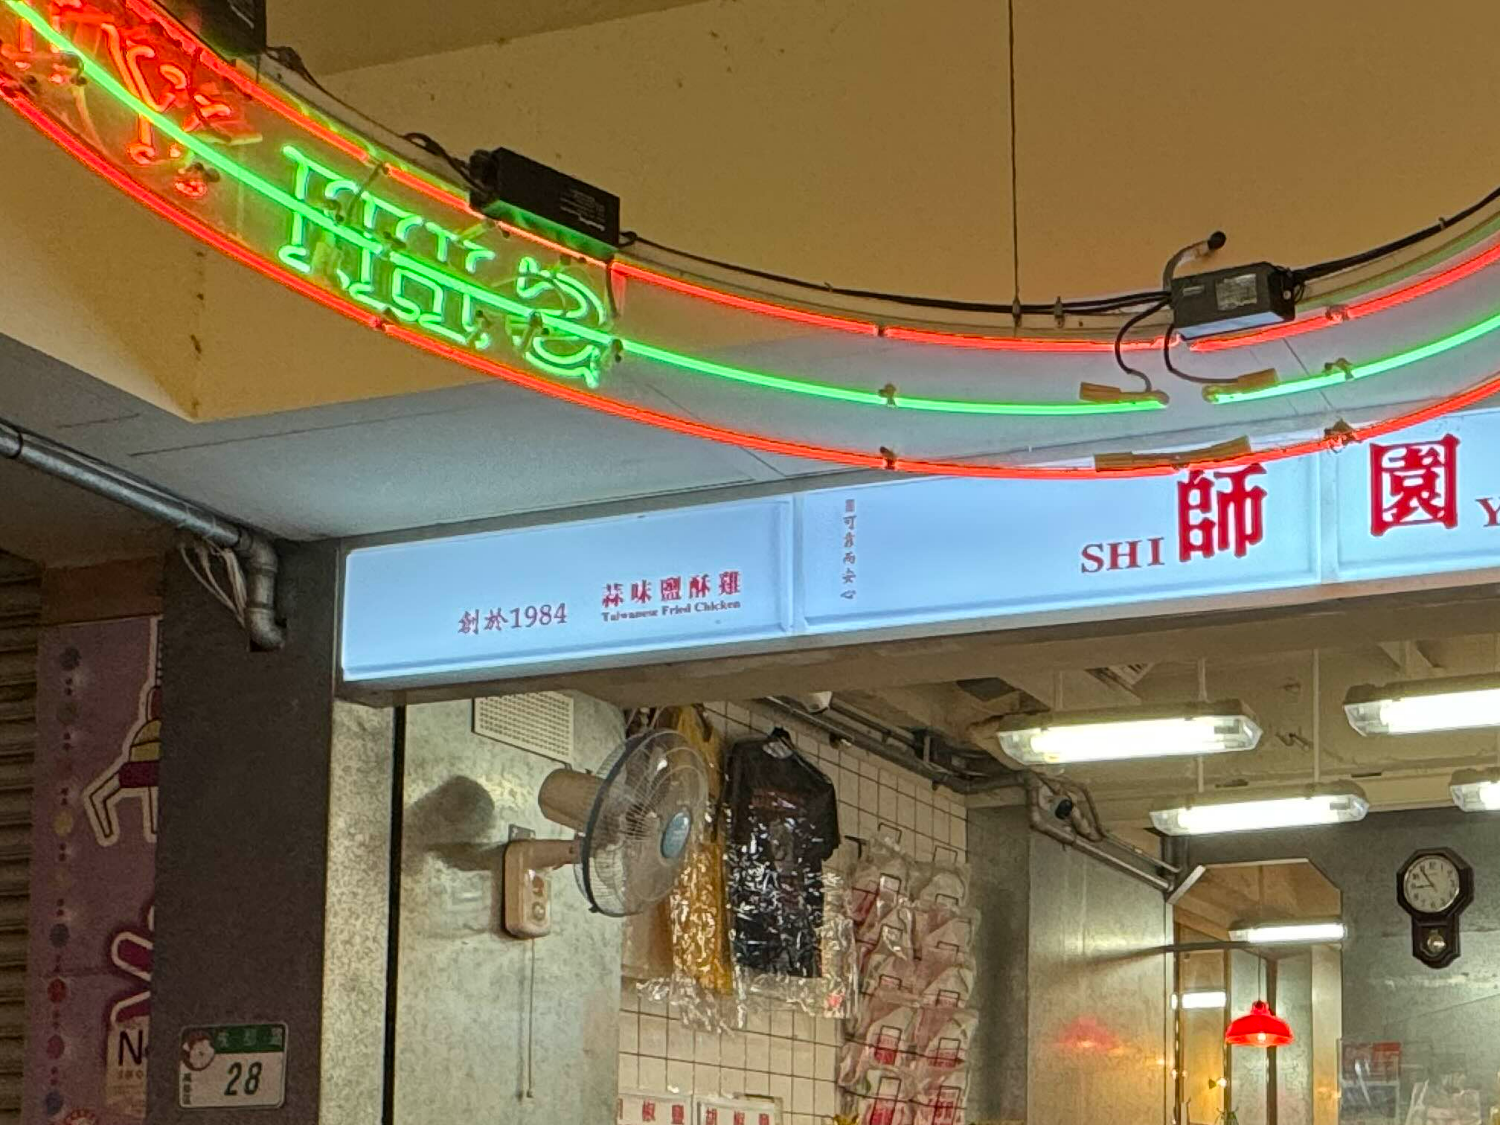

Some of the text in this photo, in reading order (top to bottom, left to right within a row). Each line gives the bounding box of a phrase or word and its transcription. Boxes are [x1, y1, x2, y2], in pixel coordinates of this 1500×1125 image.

[1081, 537, 1164, 573] SHI
[1177, 463, 1267, 562] 師
[1369, 434, 1458, 537] 園
[601, 571, 741, 606] 蒜味鹽酥雞
[457, 602, 568, 636] 創於1984
[602, 599, 741, 623] Taiwanese Fried Chicken
[224, 1061, 263, 1096] 28
